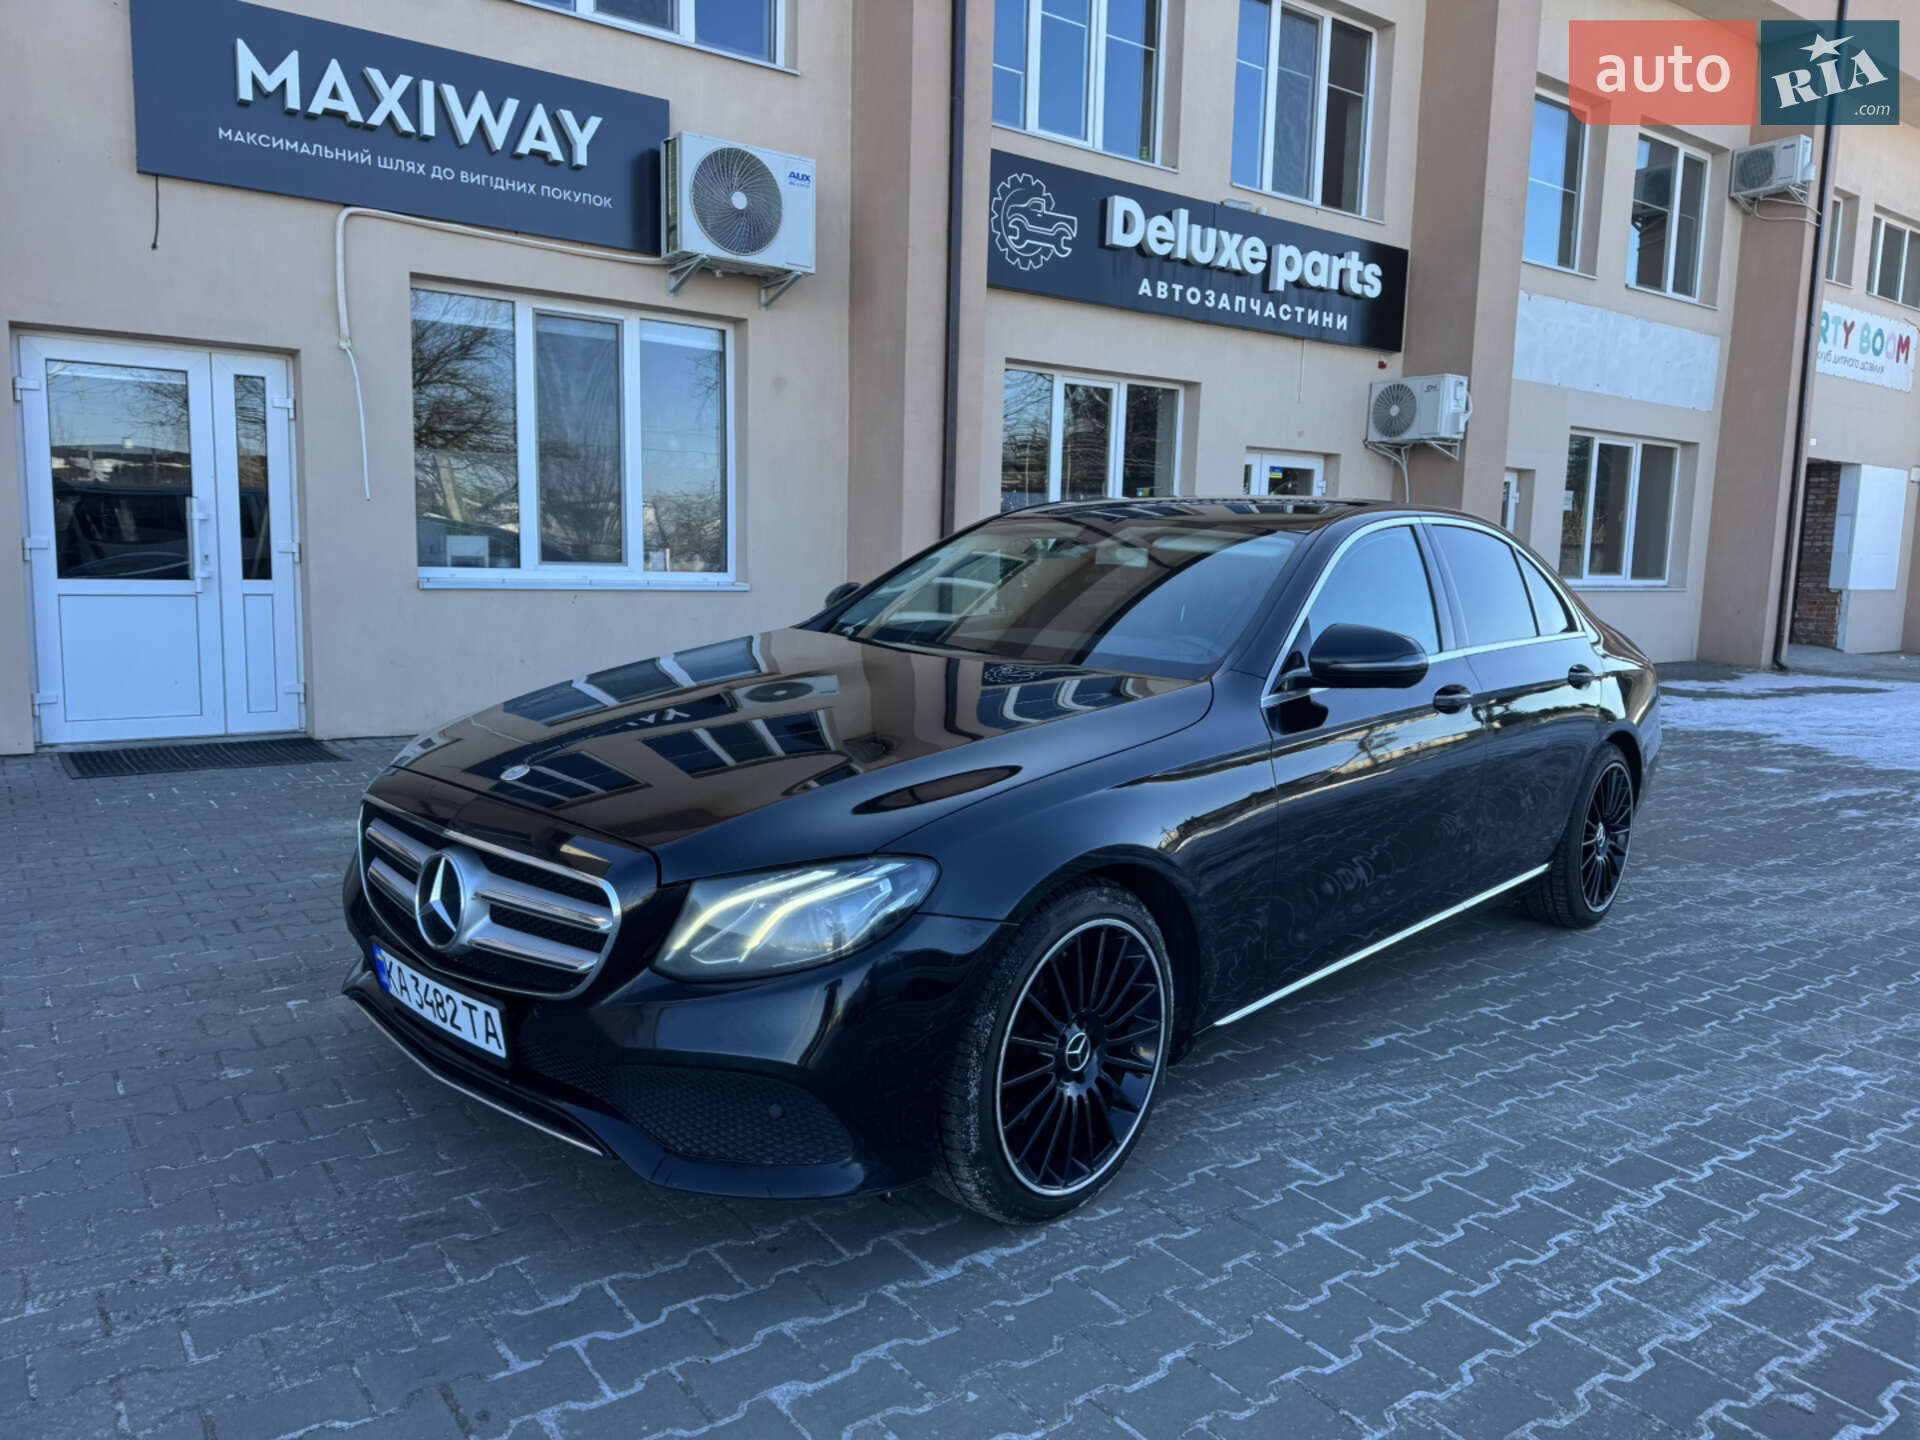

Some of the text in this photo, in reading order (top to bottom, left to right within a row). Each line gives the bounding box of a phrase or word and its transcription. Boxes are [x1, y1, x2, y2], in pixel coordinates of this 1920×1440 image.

[236, 37, 603, 170] MAXIWAY
[217, 126, 614, 209] МАКСИМАЛЬНИЙ ШЛЯХ ДО ВИГІДНИХ ПОКУПОК
[1104, 194, 1384, 299] Deluxe parts
[1137, 278, 1350, 332] АВТОЗАПЧАСТИНИ
[1859, 321, 1911, 365] BOOM
